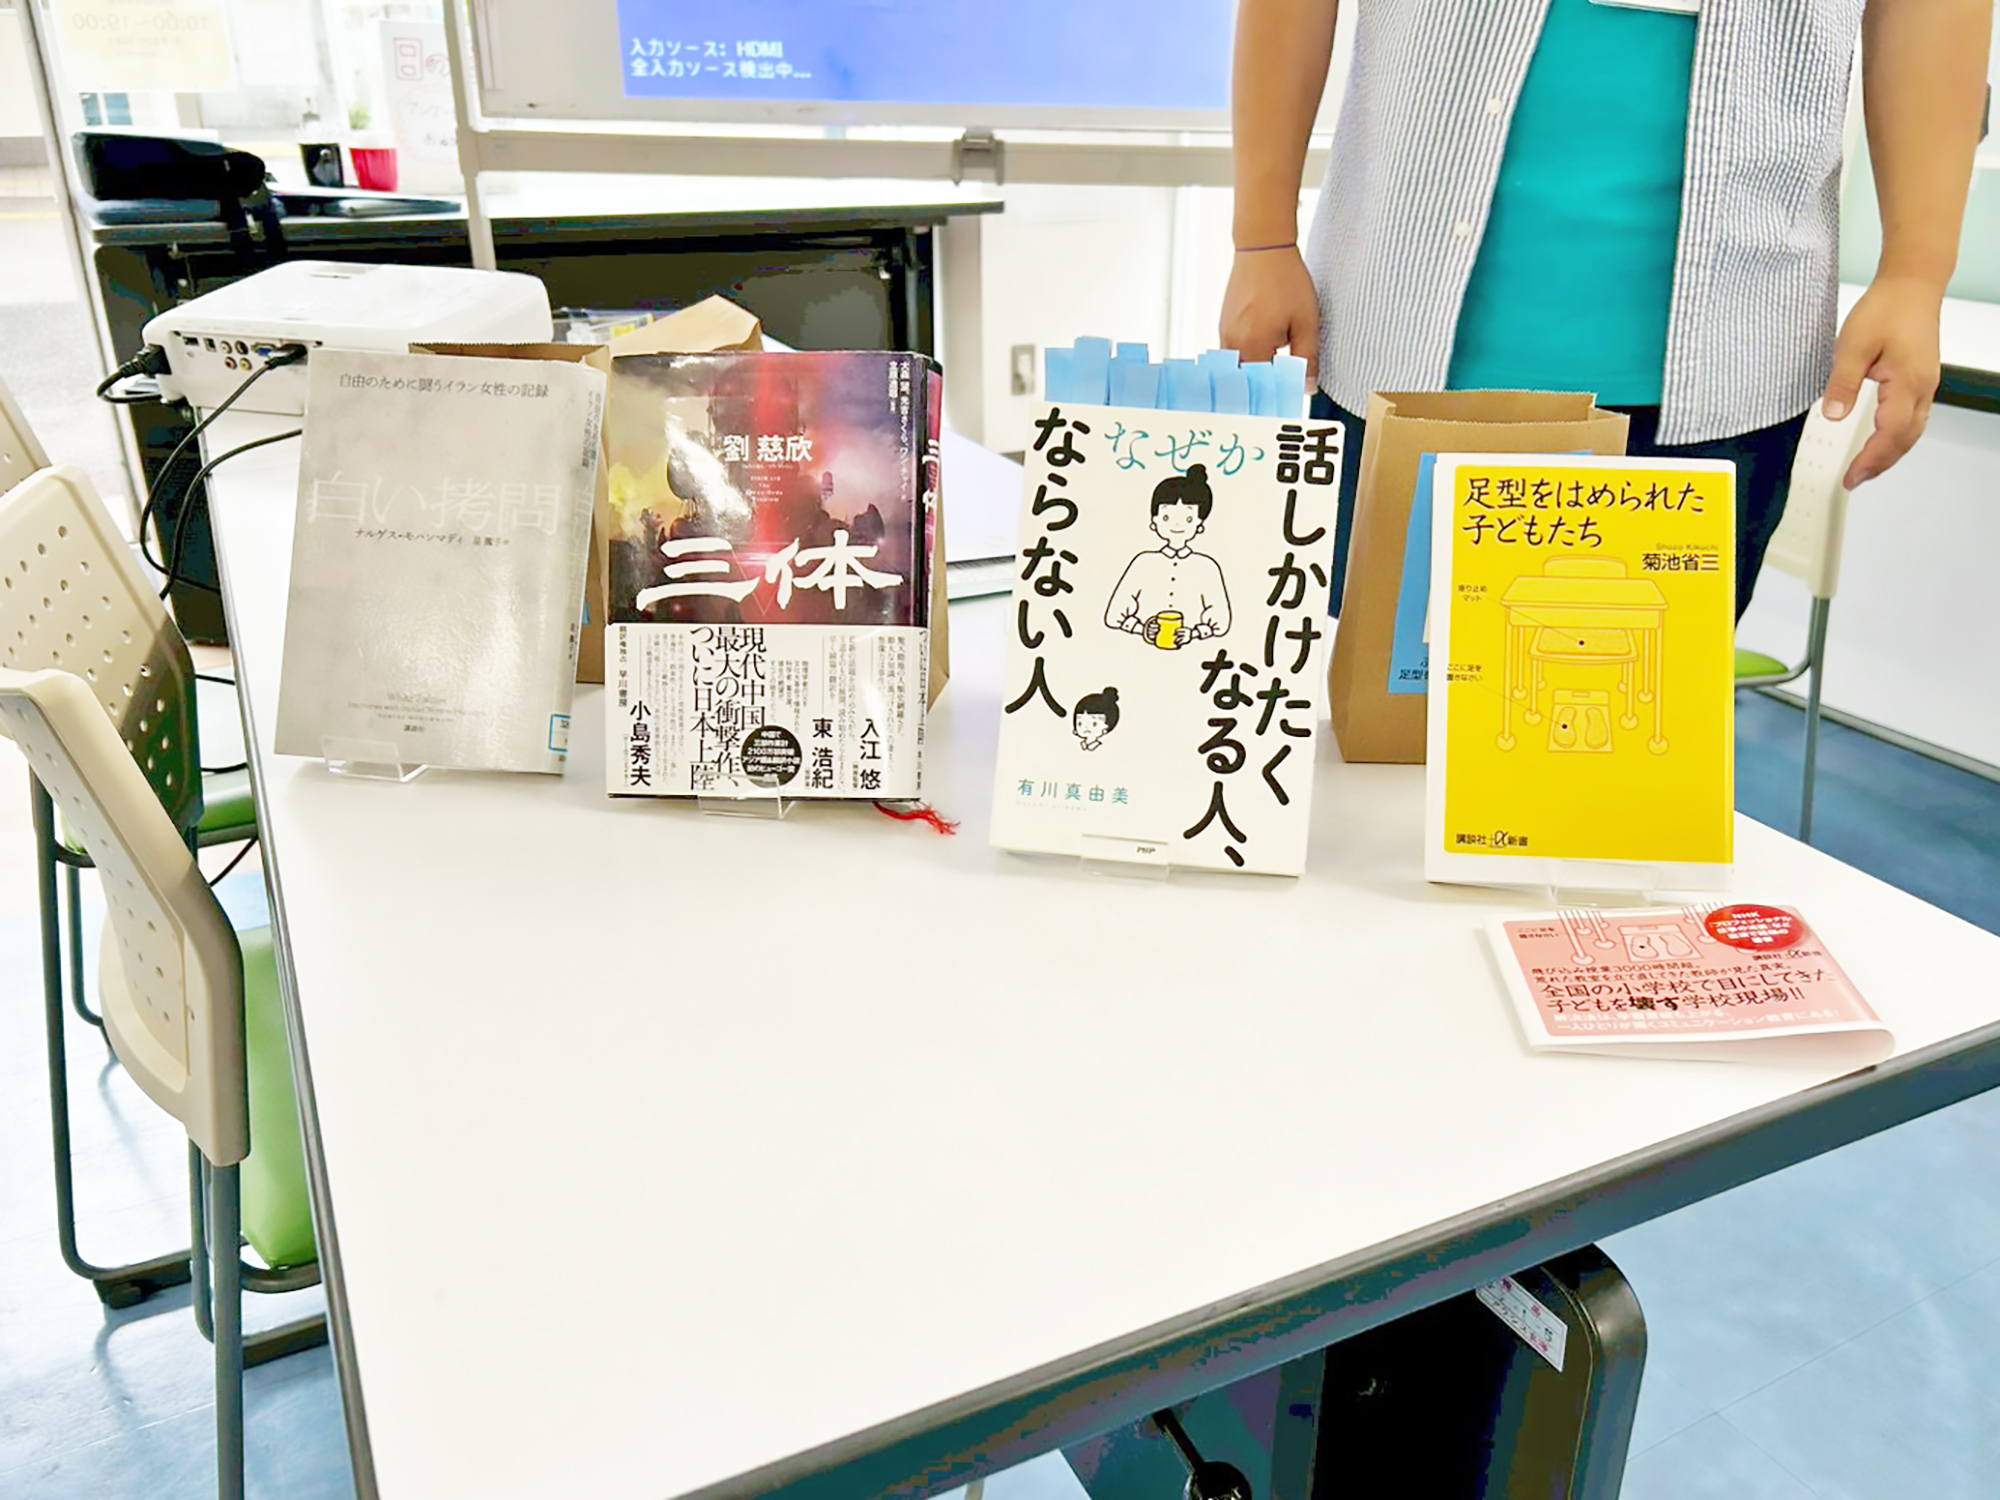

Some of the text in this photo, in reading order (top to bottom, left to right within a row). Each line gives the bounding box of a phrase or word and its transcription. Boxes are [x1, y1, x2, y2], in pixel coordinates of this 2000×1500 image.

[736, 40, 783, 58] HDMI
[339, 373, 549, 398] 自由のために闘うイラン女性の記録
[1103, 421, 1265, 476] なぜか
[307, 470, 563, 536] 白い拷問
[1462, 477, 1705, 513] 足型をはめられた
[1461, 513, 1603, 548] 子どもたち
[637, 529, 903, 611] 三体
[1004, 406, 1091, 718] ならない人
[1642, 553, 1720, 572] 菊池省三
[1256, 424, 1339, 806] 話しかけたく
[739, 627, 766, 731] 現代中国
[630, 700, 651, 786] 小島秀夫
[1182, 649, 1259, 868] なる人、
[1017, 778, 1129, 805] 有川真由美
[1541, 968, 1838, 999] 全国の小学校で目にしてきた
